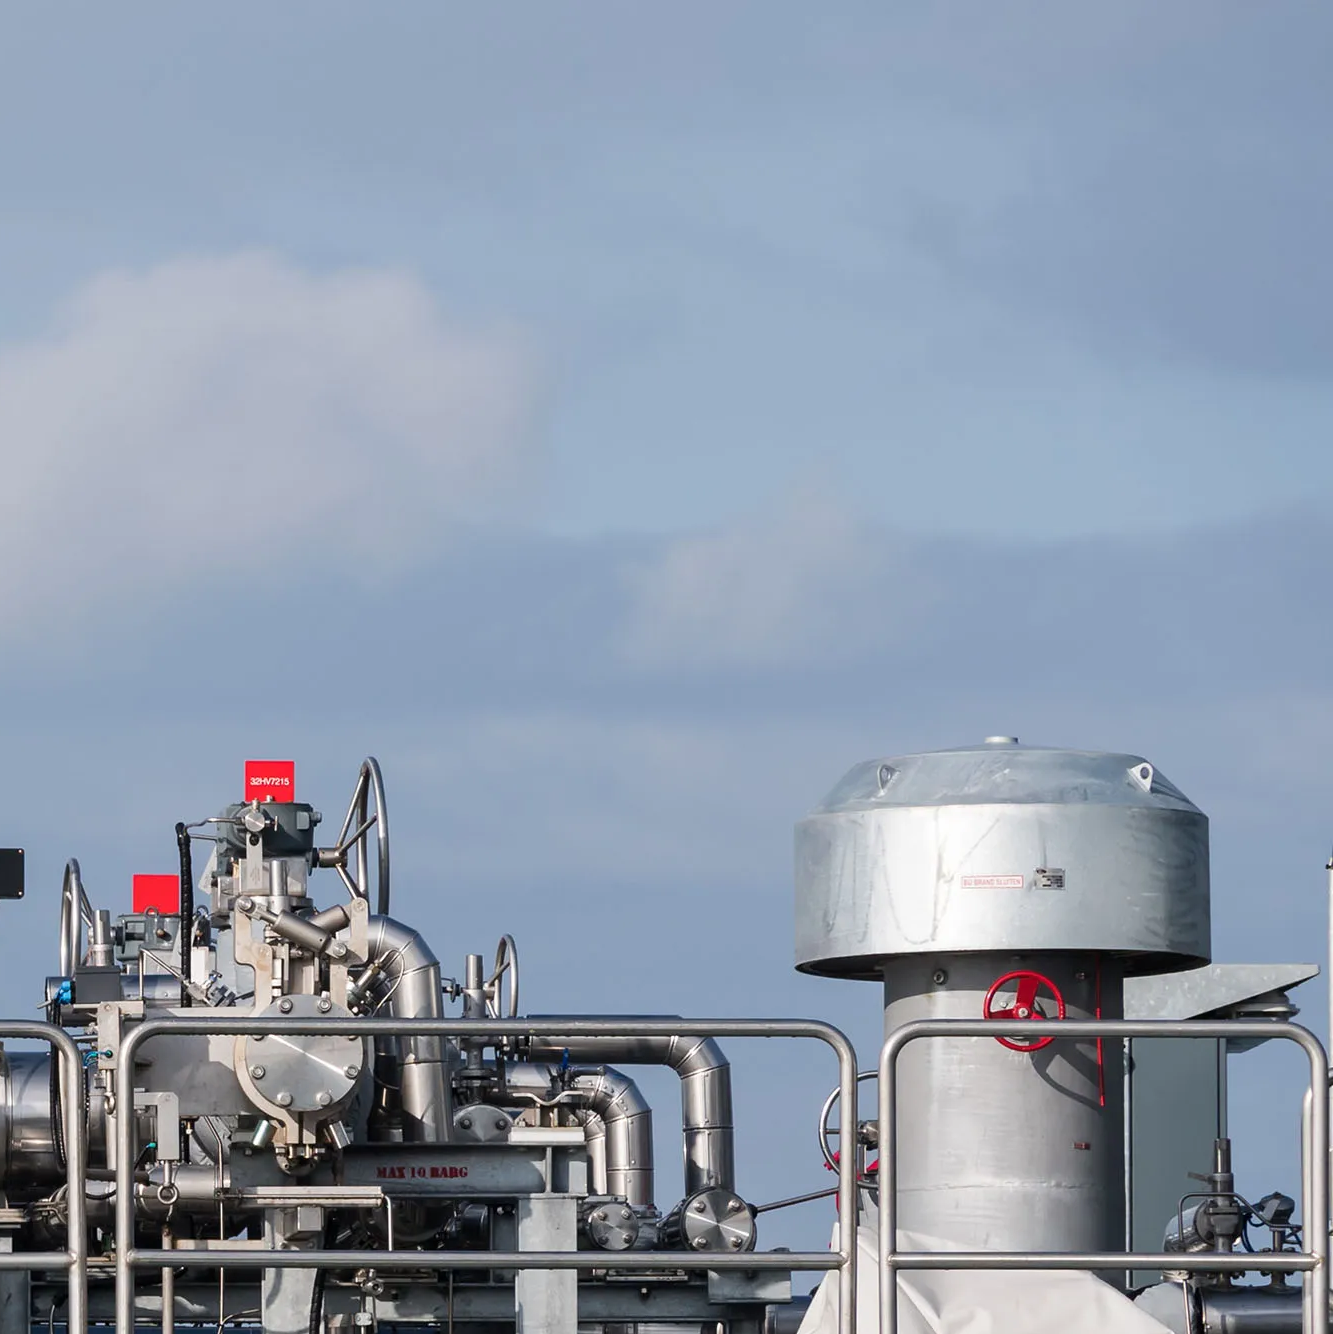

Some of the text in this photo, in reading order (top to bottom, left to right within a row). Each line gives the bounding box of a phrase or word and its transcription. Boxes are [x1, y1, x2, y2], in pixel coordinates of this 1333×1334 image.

[250, 777, 290, 786] 32HV7215
[376, 1167, 406, 1178] MAX
[410, 1166, 426, 1178] 10
